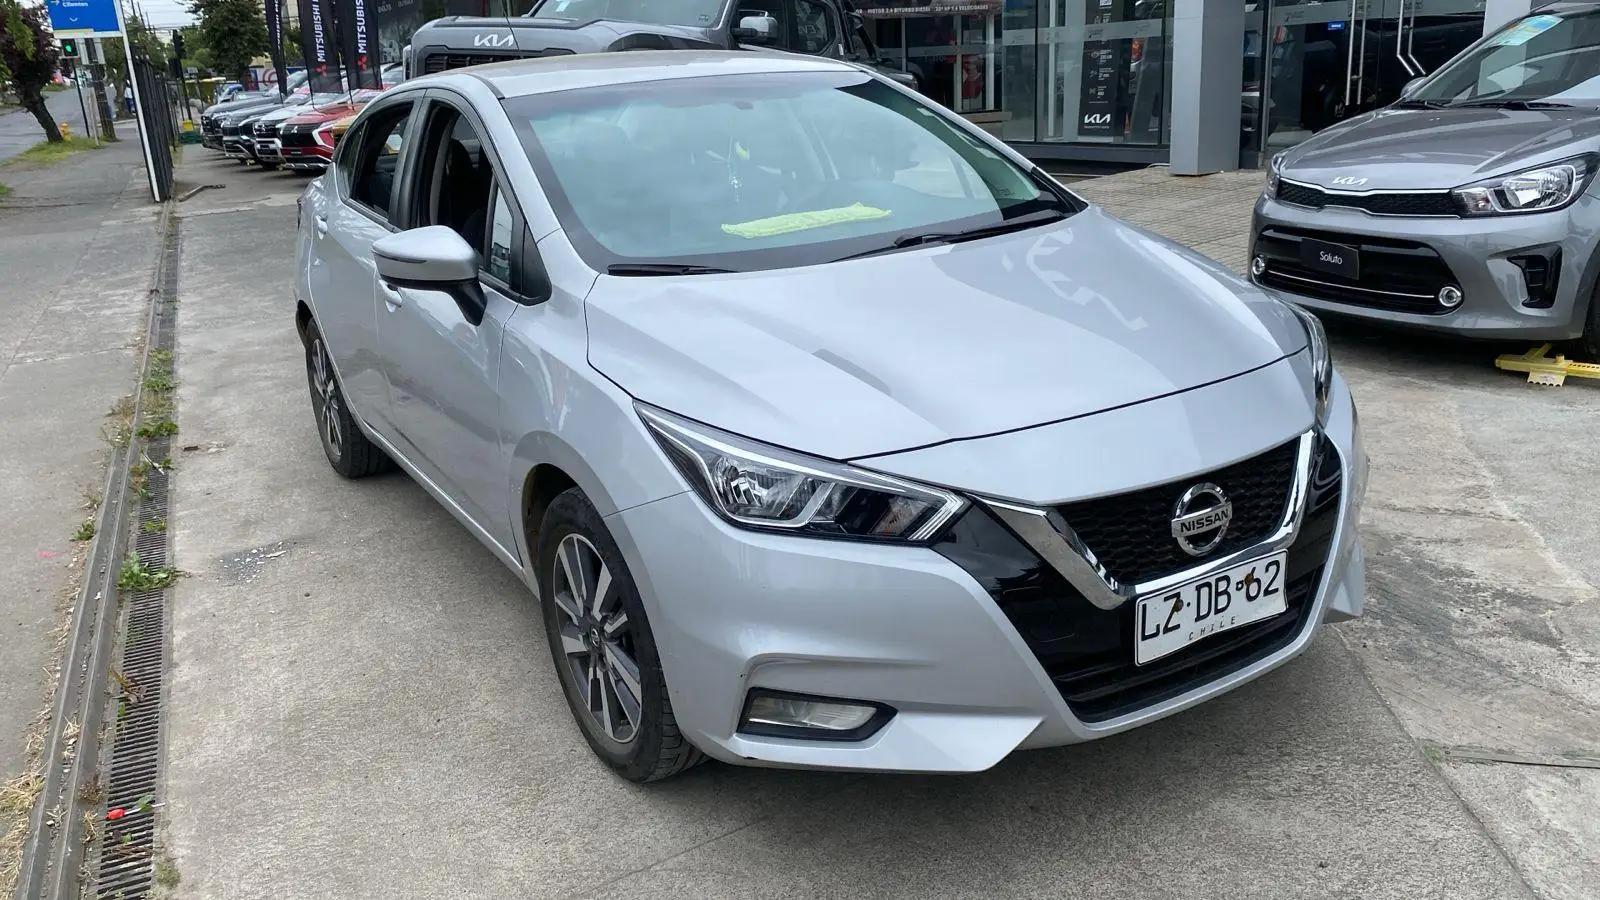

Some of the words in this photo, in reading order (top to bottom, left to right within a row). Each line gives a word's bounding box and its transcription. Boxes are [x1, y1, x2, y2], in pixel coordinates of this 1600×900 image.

[312, 4, 326, 62] MITSUBISHI
[474, 34, 515, 47] KIA
[1084, 113, 1111, 124] KIA
[1332, 176, 1369, 186] KIA
[1319, 251, 1343, 265] Soluto
[1180, 508, 1229, 533] NISSAN
[1188, 615, 1236, 641] CHILE
